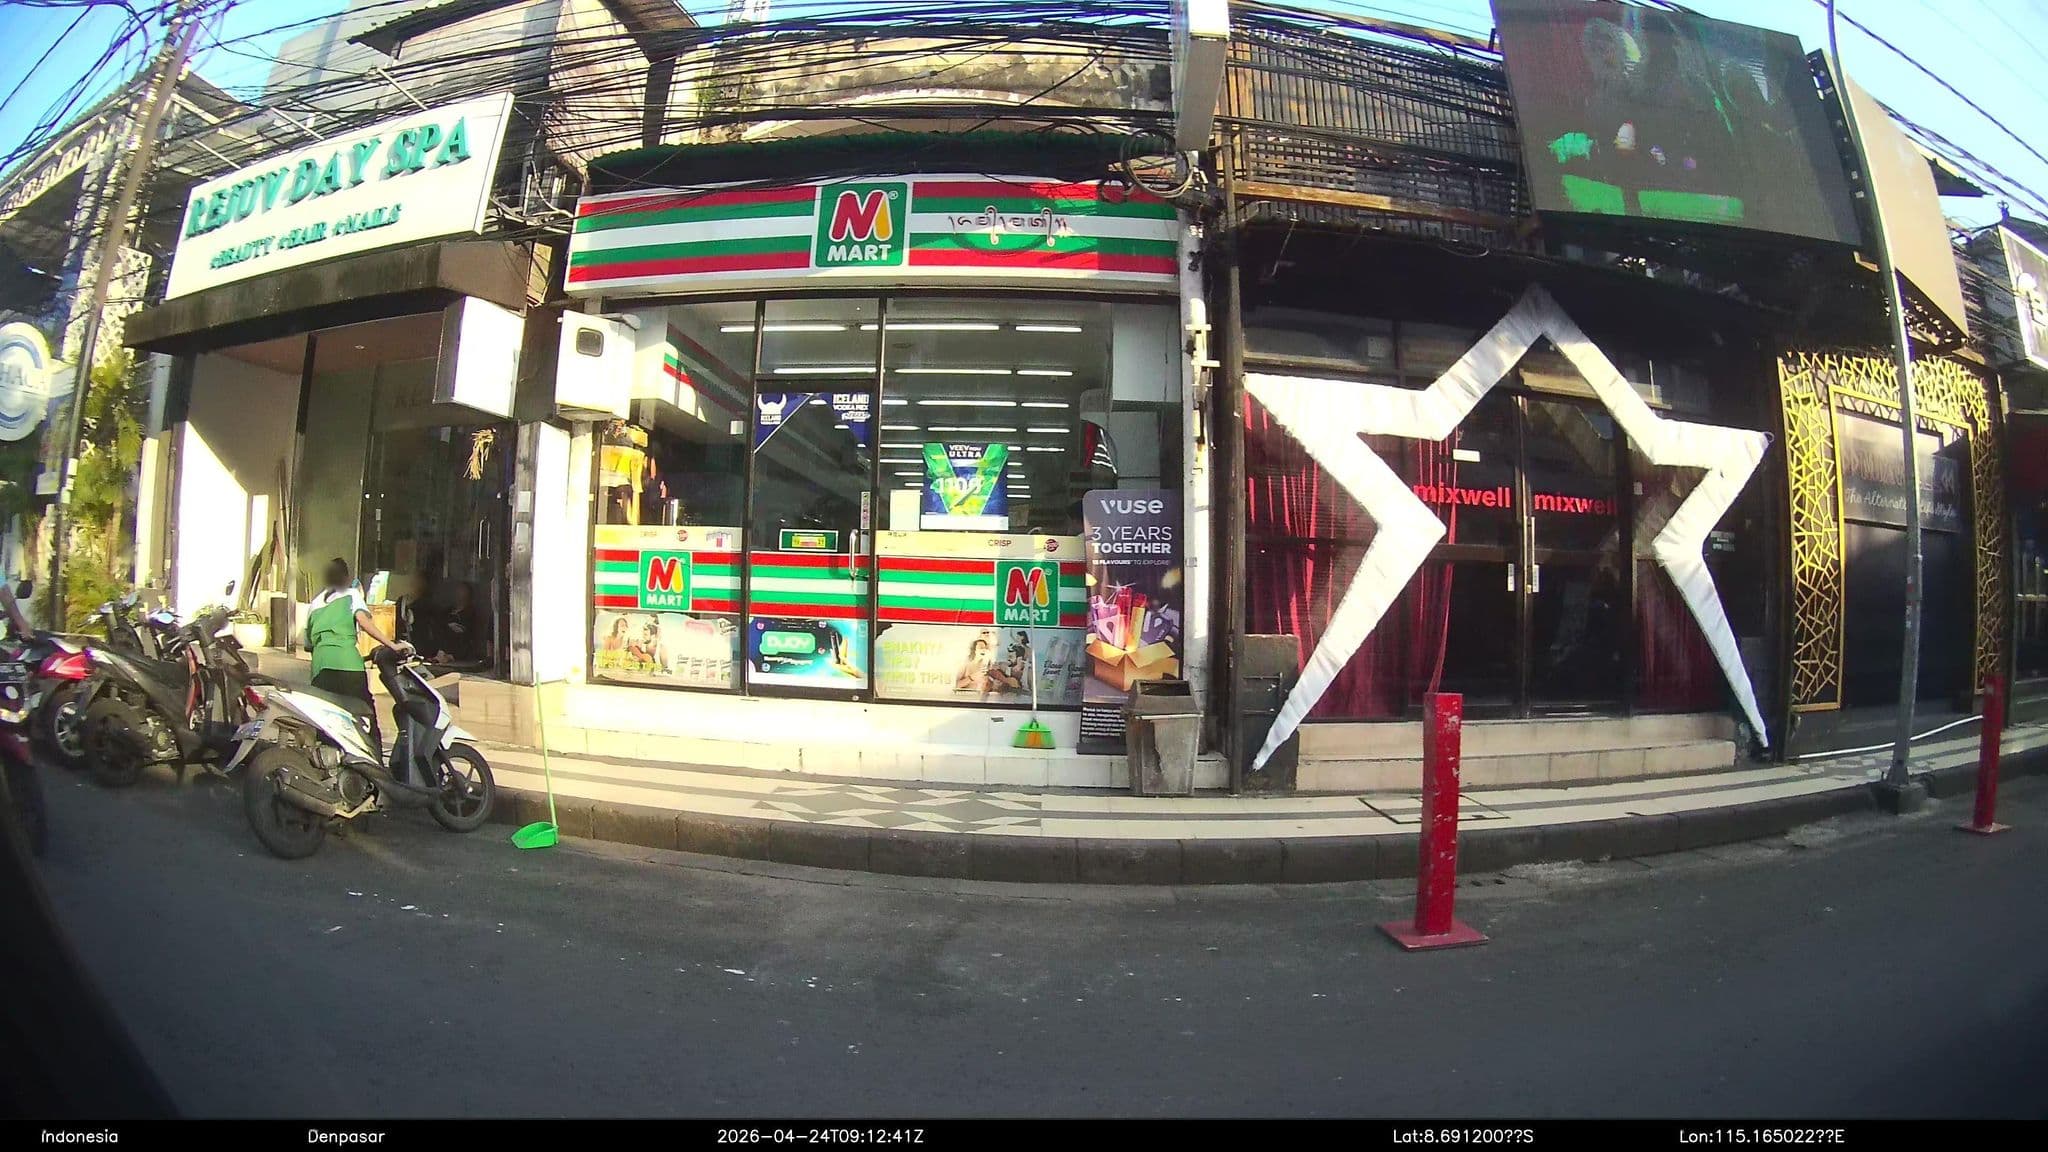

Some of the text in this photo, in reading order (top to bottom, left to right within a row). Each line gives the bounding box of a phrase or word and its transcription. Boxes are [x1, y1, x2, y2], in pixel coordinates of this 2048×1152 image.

[184, 166, 289, 240] REJUV
[286, 137, 382, 207] DAY
[382, 116, 471, 181] SPA
[218, 204, 402, 269] BEAUTY HAIR NAILS
[827, 244, 892, 262] MART
[1413, 482, 1511, 508] mixwell
[1534, 492, 1618, 516] mixwell
[1091, 526, 1172, 541] 3 YEARS
[987, 539, 1012, 548] CRISP
[1091, 542, 1171, 554] TOGETHER
[646, 593, 684, 606] MART
[1004, 608, 1050, 622] MART
